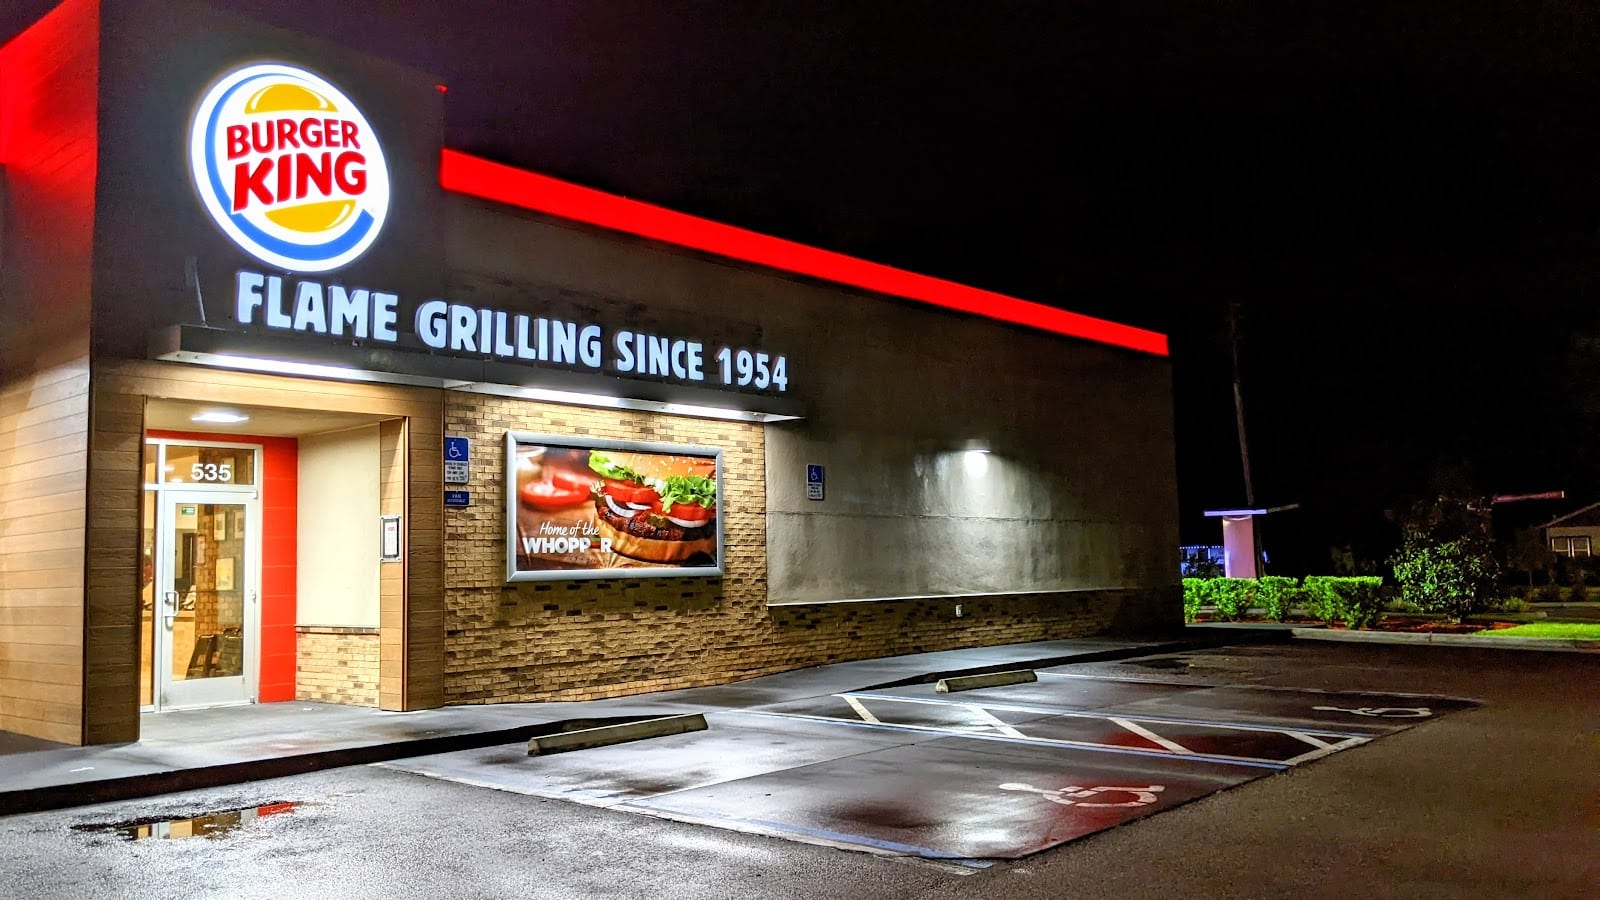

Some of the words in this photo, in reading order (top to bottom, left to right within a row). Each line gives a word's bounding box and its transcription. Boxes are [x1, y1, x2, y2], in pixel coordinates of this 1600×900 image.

[227, 117, 360, 160] BURGER
[234, 150, 367, 211] KING
[238, 271, 398, 342] FLAME
[415, 300, 601, 368] GRILLING
[614, 331, 704, 381] SINCE
[717, 348, 788, 391] 1954
[190, 463, 232, 482] 535
[540, 521, 568, 536] Home
[569, 520, 582, 538] of
[582, 521, 600, 536] the
[522, 537, 614, 554] WHOPPR
